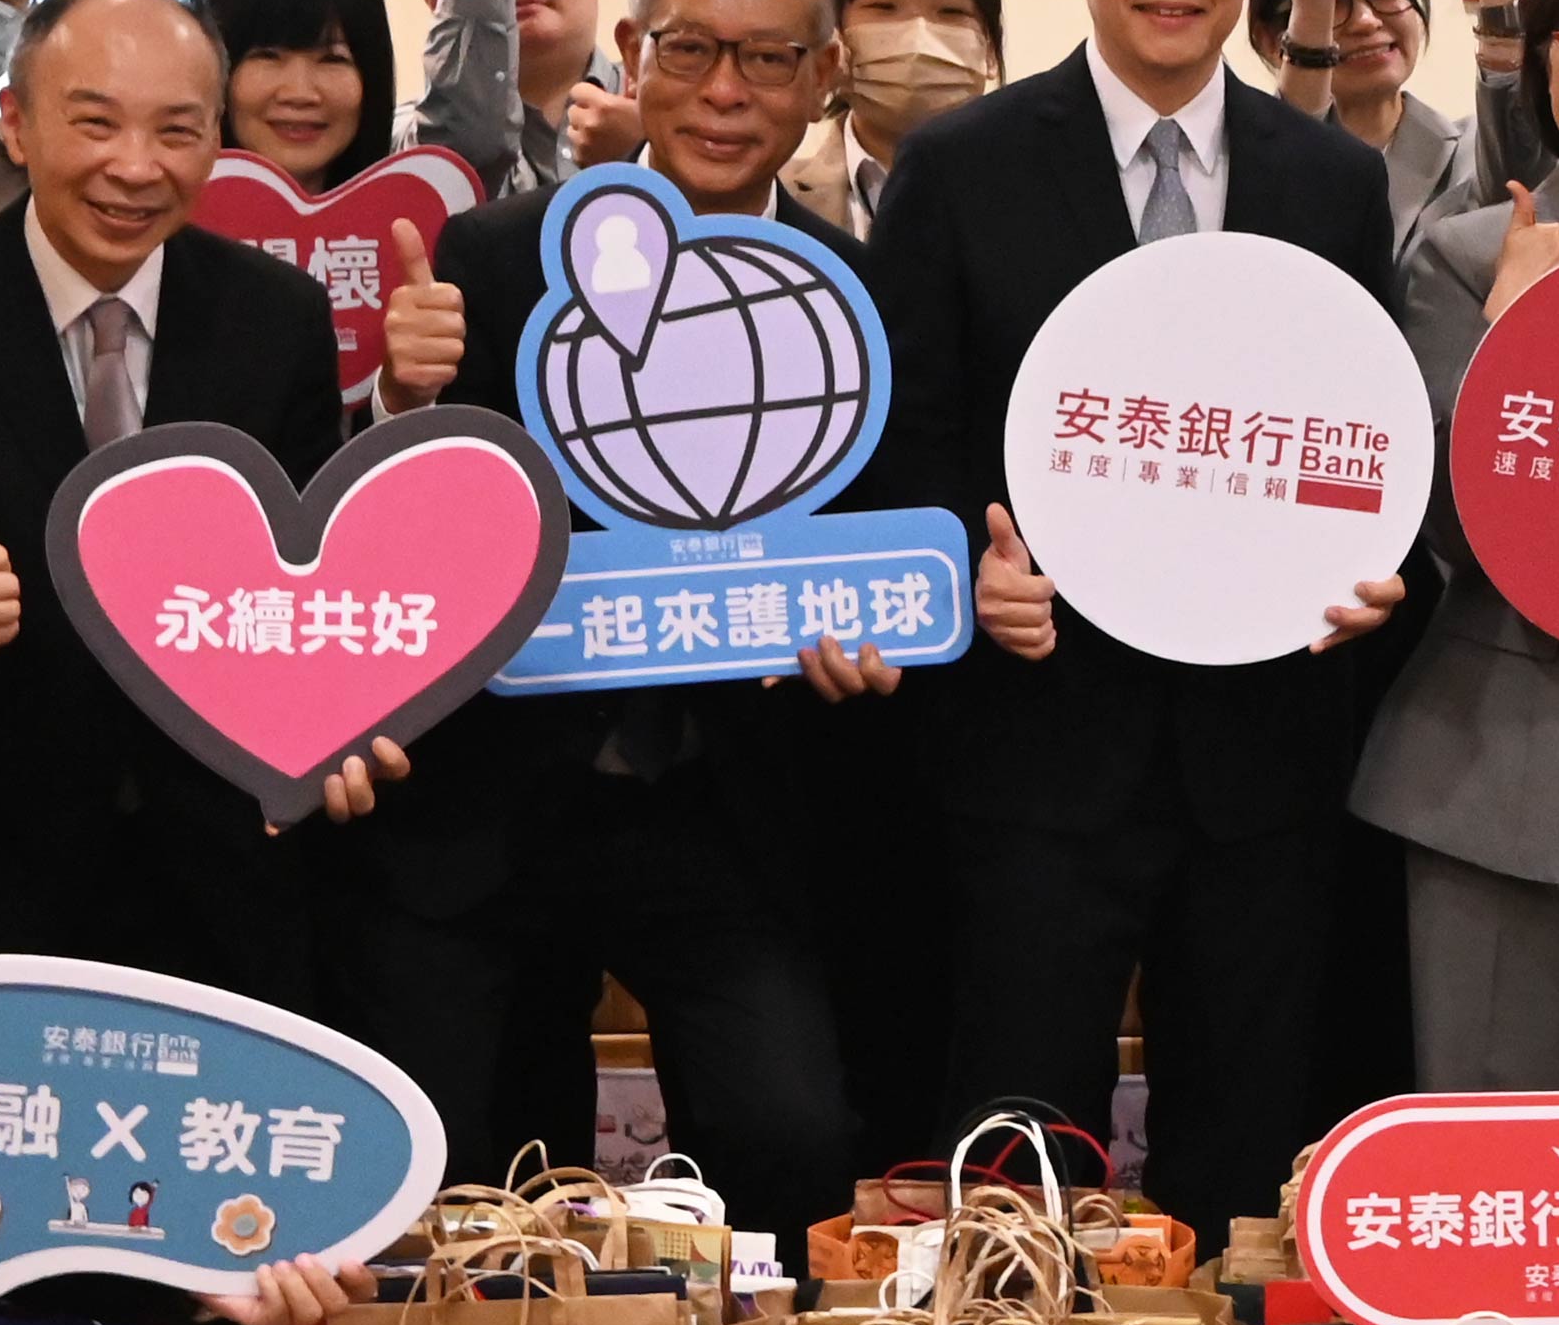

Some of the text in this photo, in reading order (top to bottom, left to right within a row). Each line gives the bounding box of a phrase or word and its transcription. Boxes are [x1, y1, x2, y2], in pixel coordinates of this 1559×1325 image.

[1054, 386, 1294, 470] 安泰銀行
[1302, 416, 1390, 453] EnTie
[1048, 445, 1287, 503] 速度 專業 信賴
[1299, 446, 1386, 482] Bank
[1492, 447, 1552, 481] 速度
[155, 586, 438, 659] 永續共好
[531, 572, 934, 660] 一起來護地球
[43, 1025, 154, 1058] 安泰銀行
[179, 1097, 345, 1180] 教育
